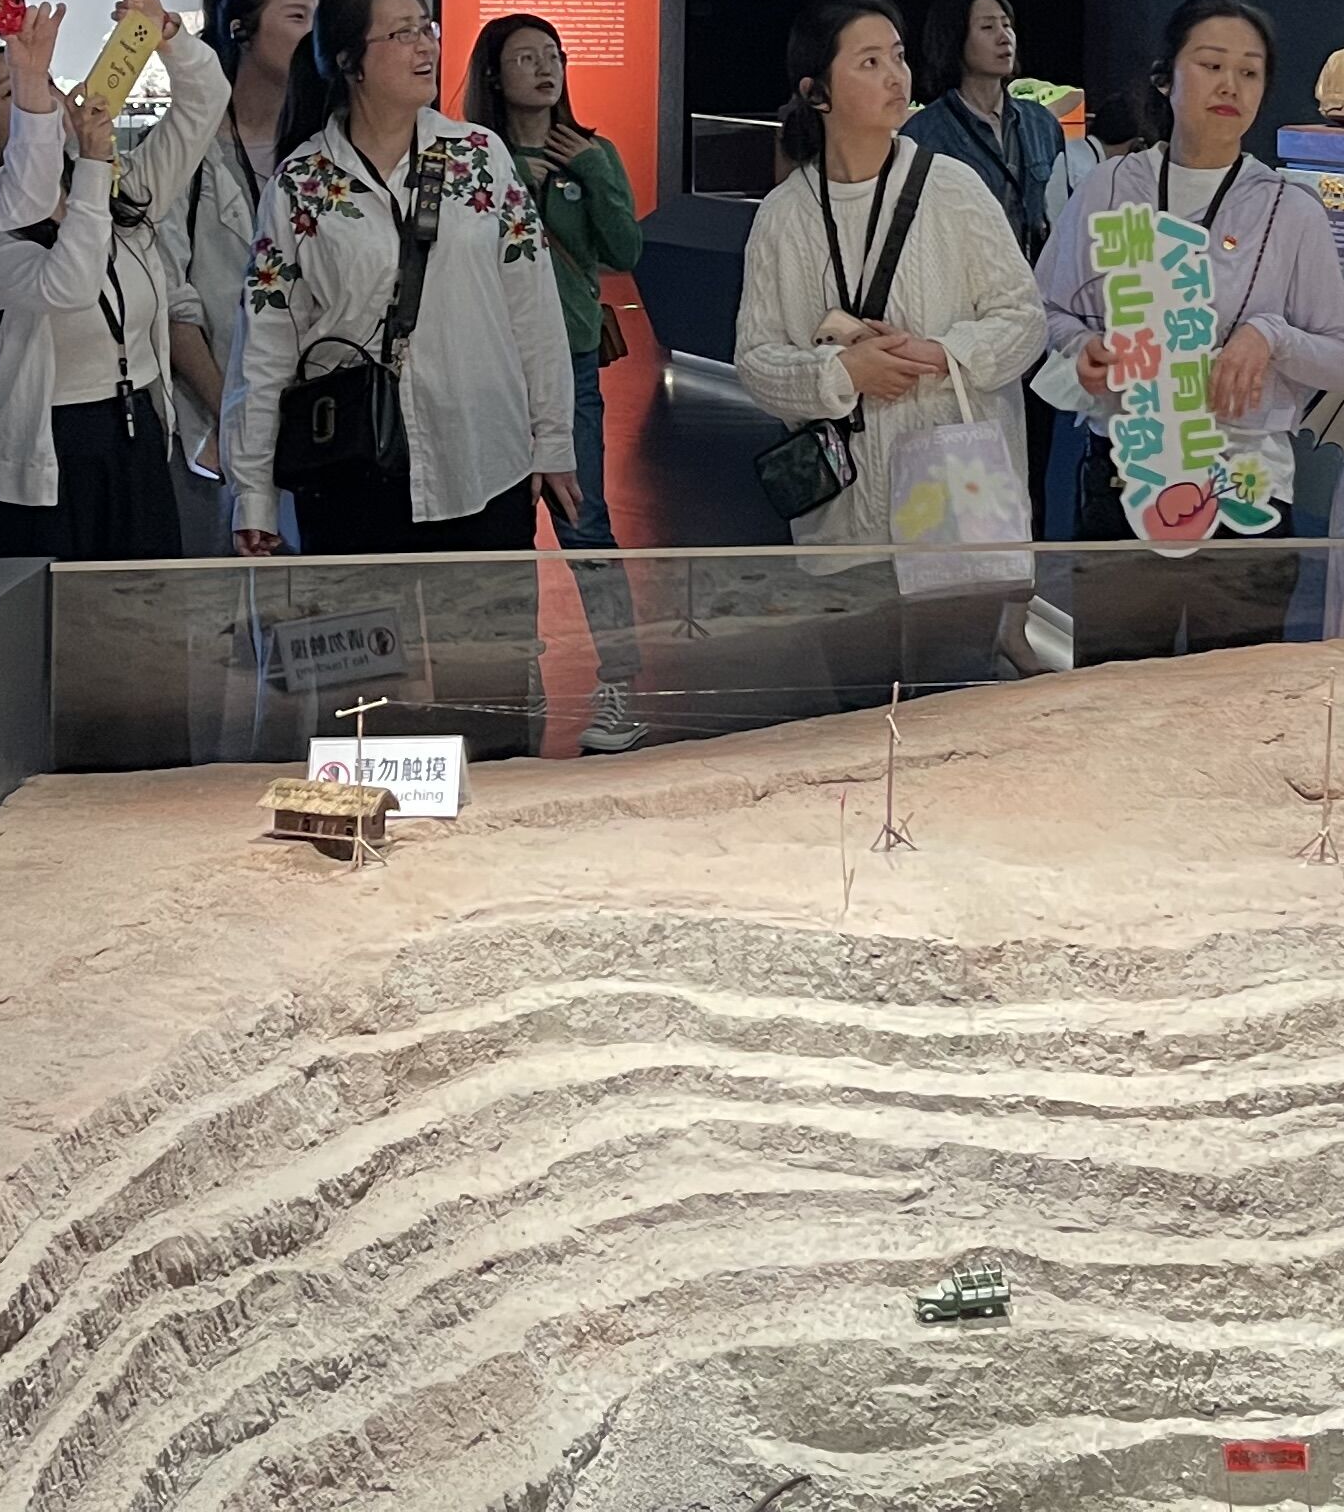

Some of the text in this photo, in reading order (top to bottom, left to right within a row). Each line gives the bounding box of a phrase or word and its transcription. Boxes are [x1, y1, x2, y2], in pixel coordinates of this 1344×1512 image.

[354, 756, 447, 782] 请勿触摸
[396, 788, 444, 804] uching
